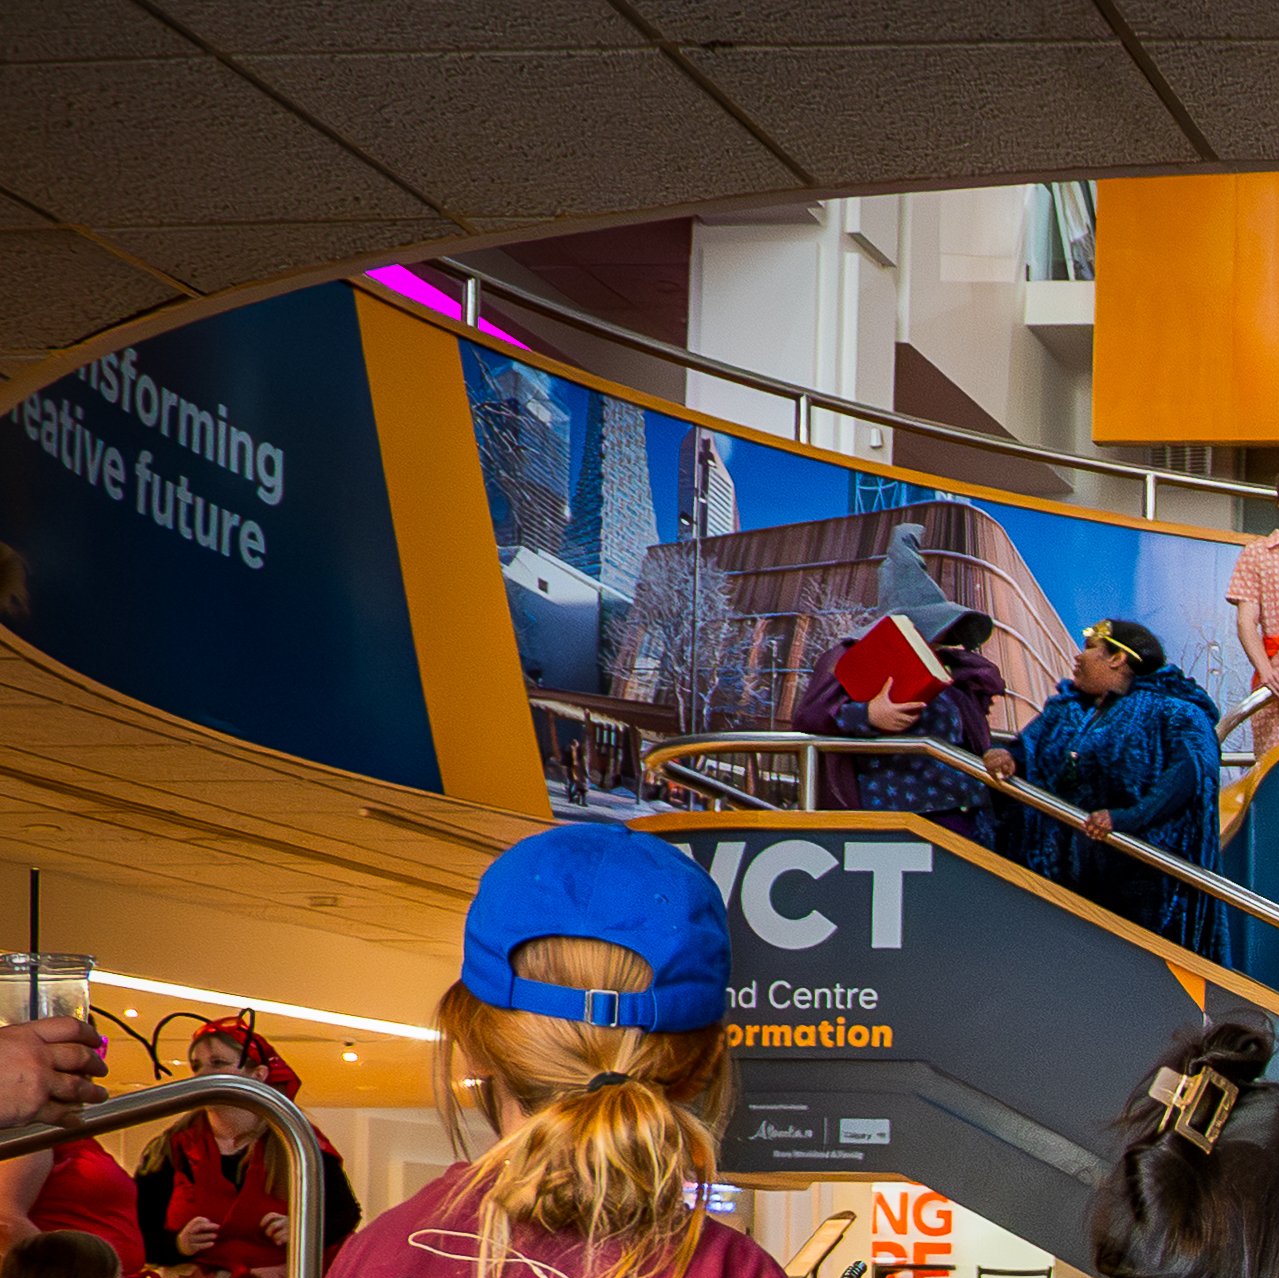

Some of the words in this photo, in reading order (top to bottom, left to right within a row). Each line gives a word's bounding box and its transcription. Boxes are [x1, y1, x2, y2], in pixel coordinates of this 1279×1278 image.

[78, 348, 284, 506] nsforming
[136, 450, 266, 569] future
[726, 1016, 893, 1048] ormation
[768, 980, 879, 1010] Centre
